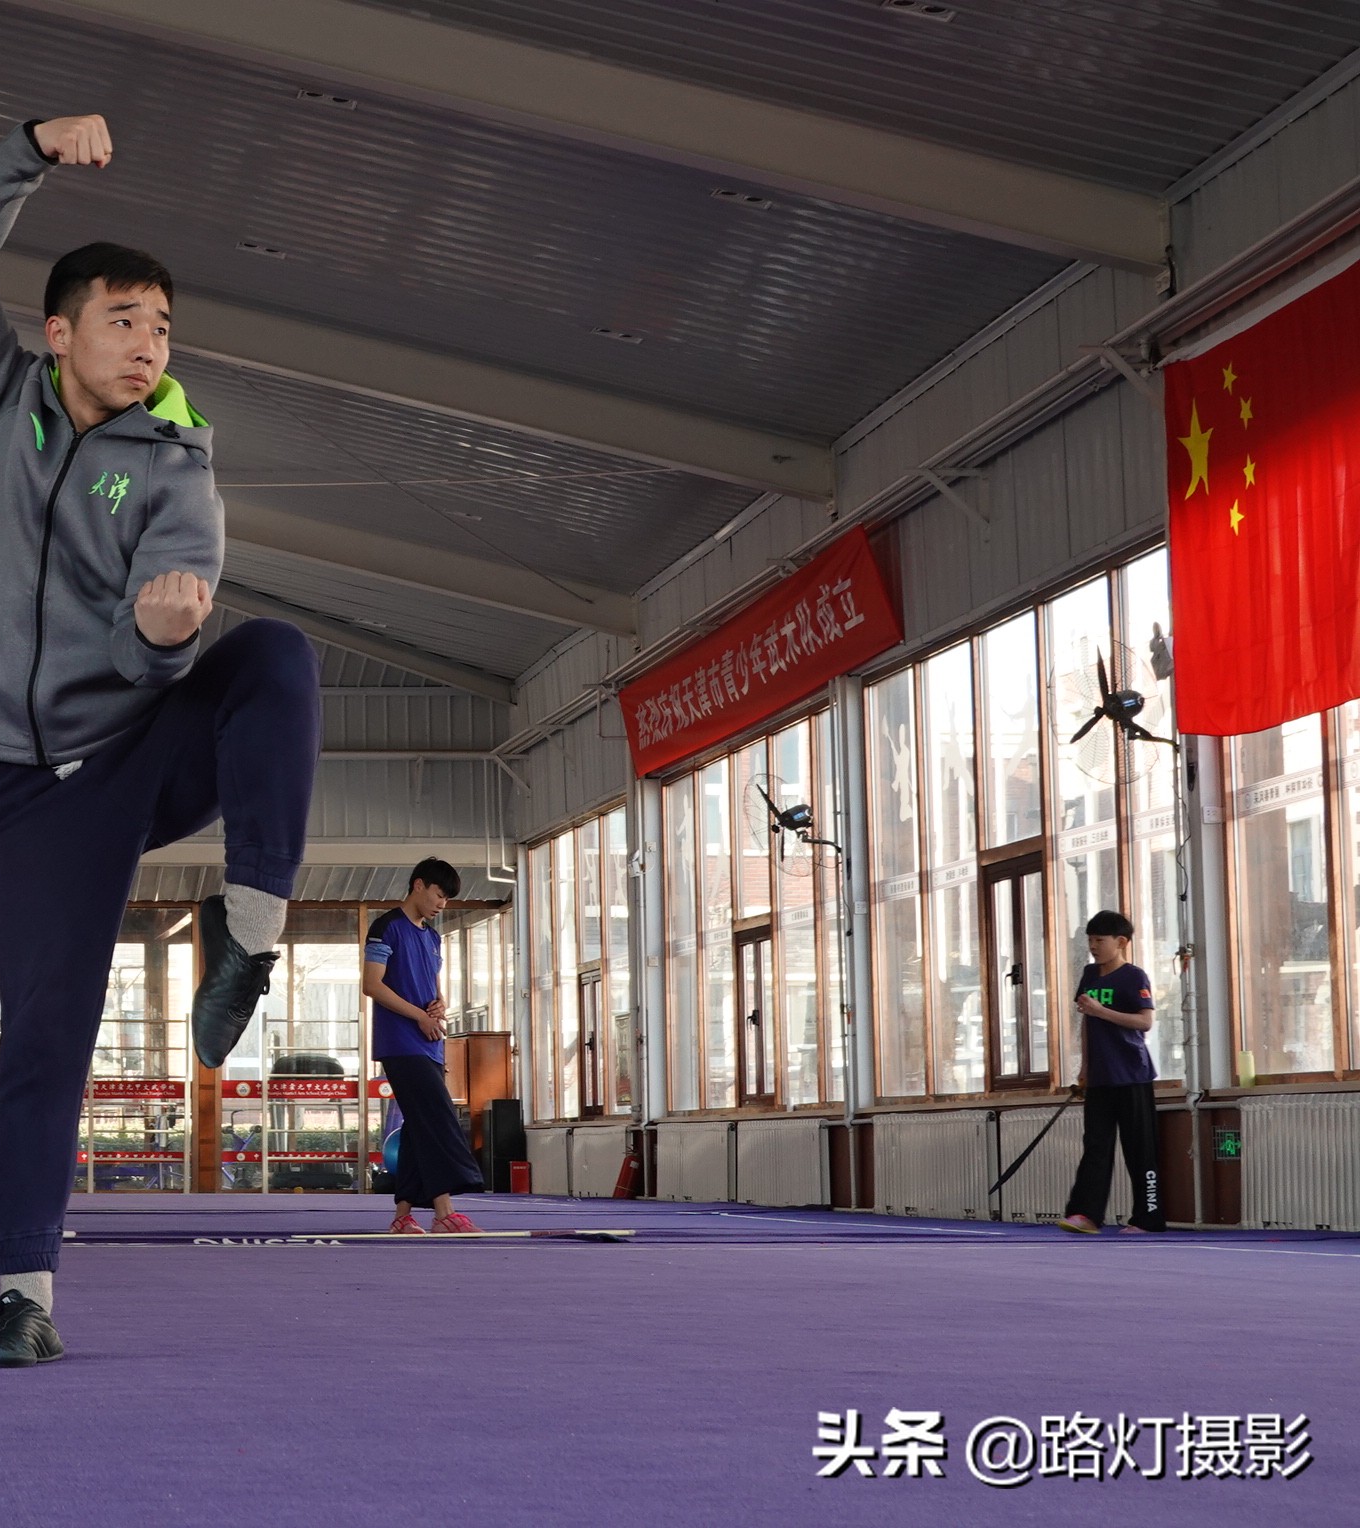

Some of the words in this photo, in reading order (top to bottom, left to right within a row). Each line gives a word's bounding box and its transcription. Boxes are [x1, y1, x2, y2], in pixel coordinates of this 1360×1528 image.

[634, 576, 868, 750] 热烈庆祝天津市青少年武术队成立
[1145, 1169, 1158, 1213] CHINA
